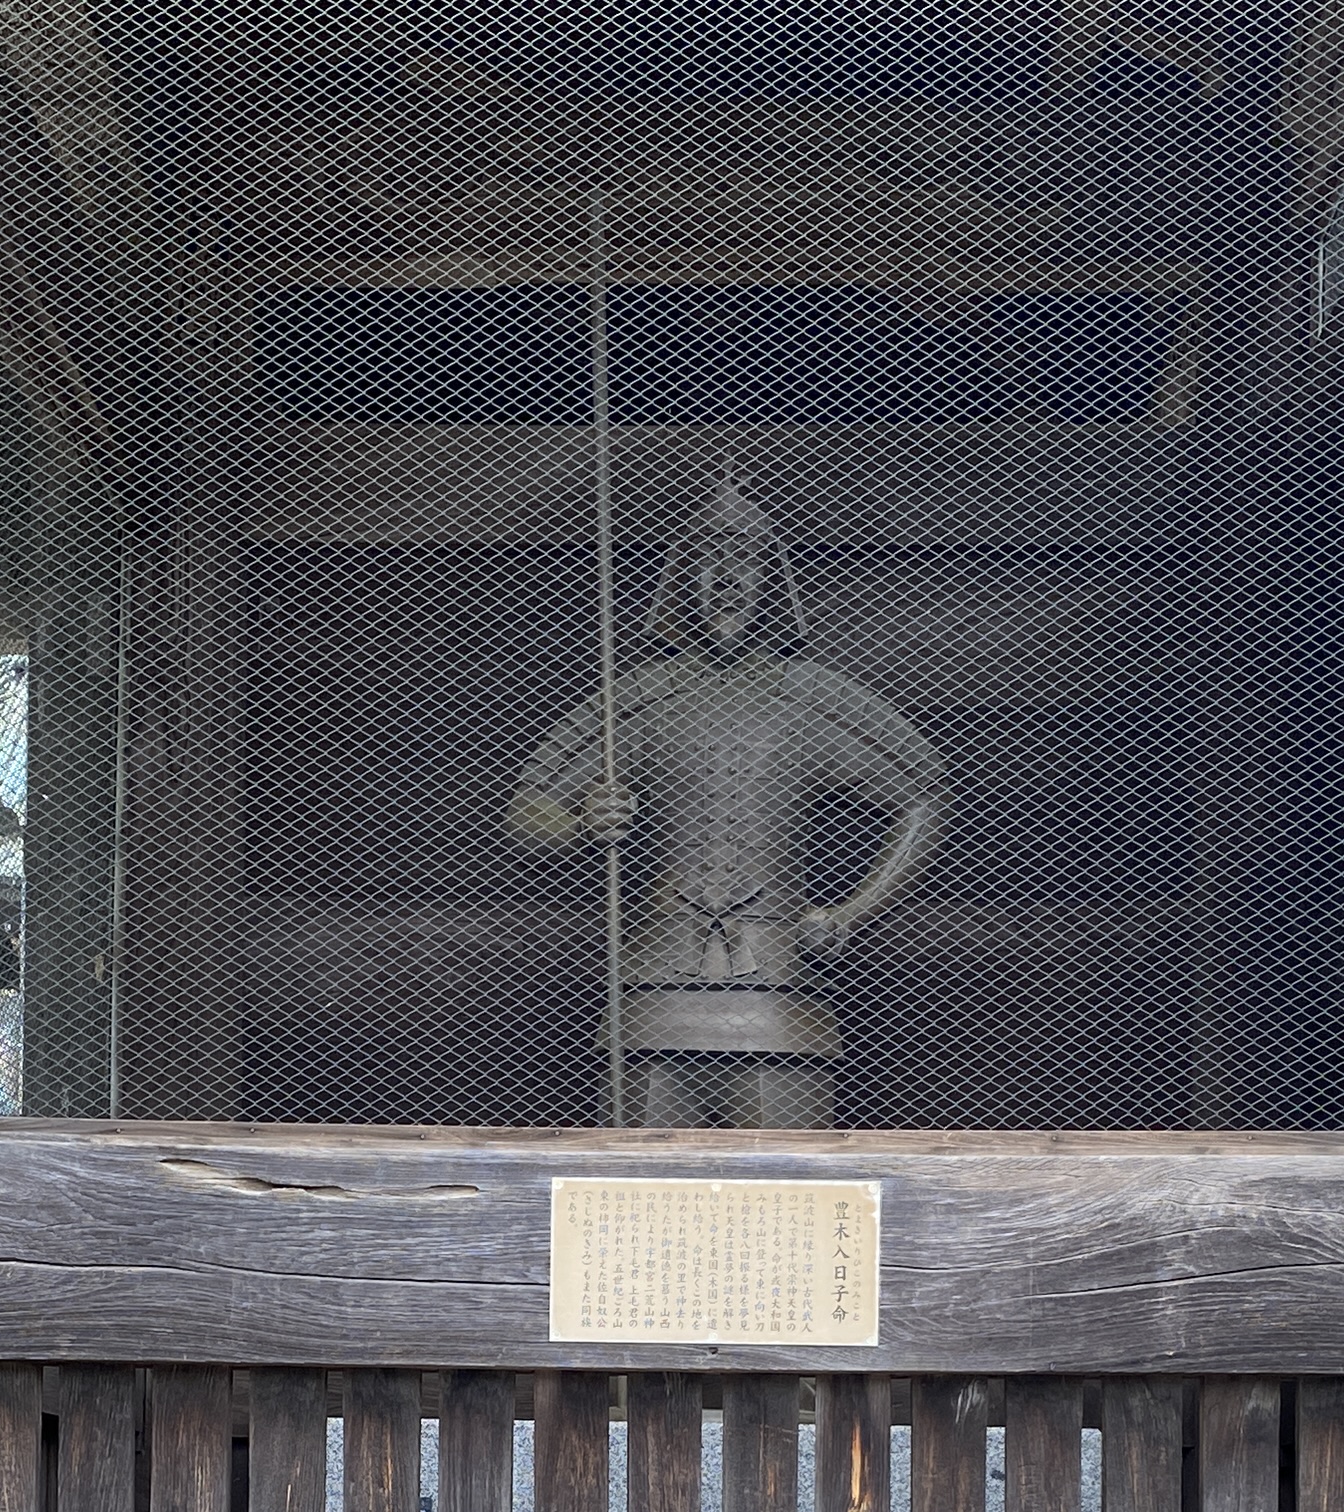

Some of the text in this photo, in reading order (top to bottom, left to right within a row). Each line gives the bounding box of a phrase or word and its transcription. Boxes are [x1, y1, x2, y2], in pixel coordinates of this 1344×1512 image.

[831, 1201, 851, 1325] 豊木入日子命
